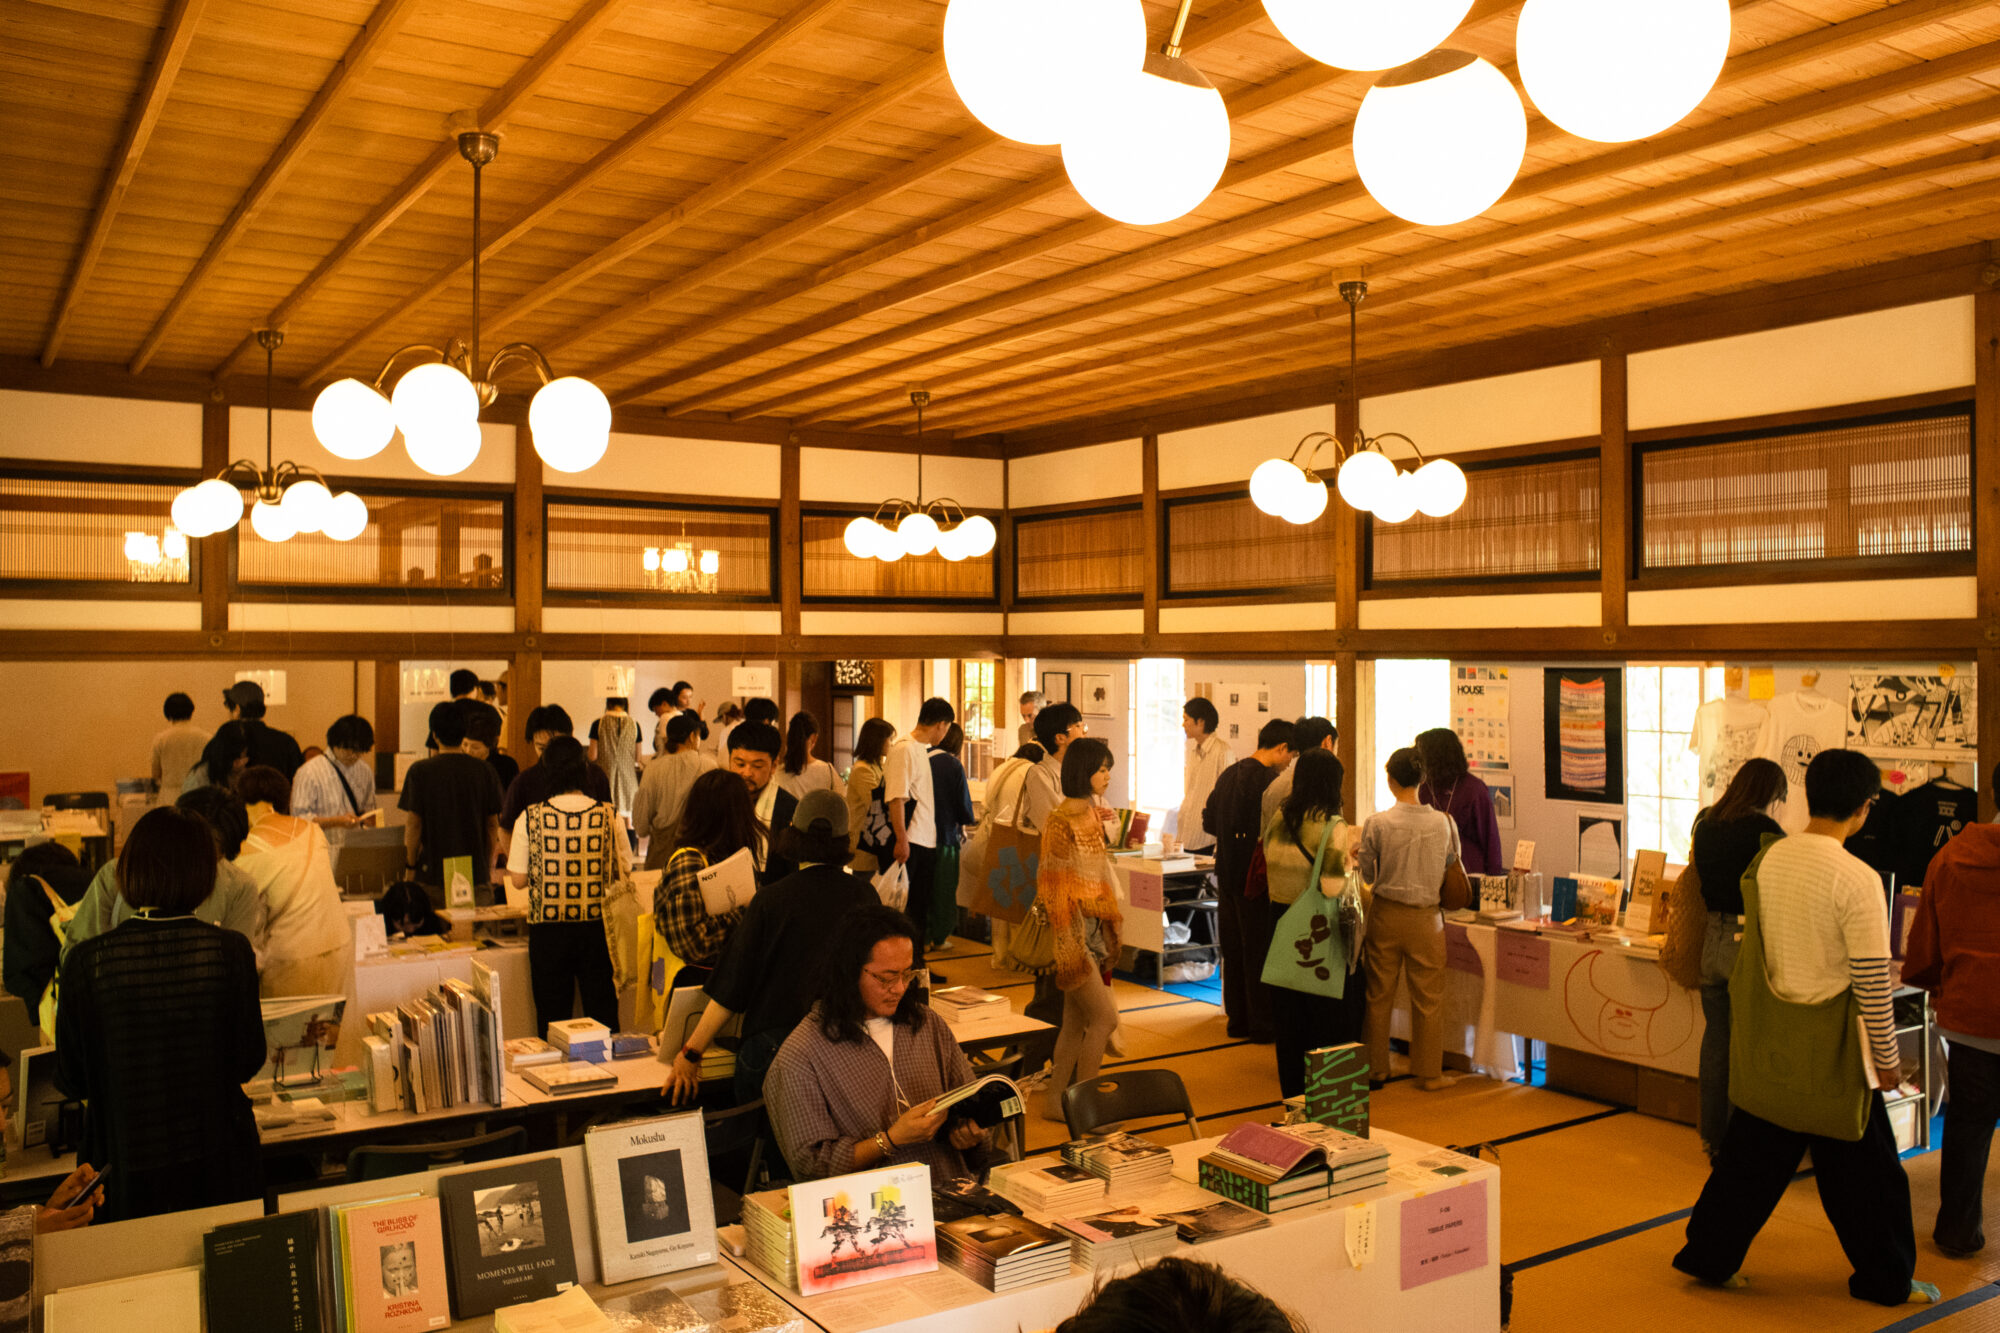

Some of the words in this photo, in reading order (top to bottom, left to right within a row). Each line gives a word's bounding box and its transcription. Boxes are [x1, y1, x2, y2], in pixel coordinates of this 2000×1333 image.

[1457, 684, 1485, 695] HOUSE
[701, 872, 717, 882] NOT
[630, 1131, 665, 1146] Mokusha
[372, 1219, 386, 1228] THE
[387, 1216, 407, 1225] BLISS
[377, 1221, 415, 1233] GIRLHOOD
[477, 1266, 516, 1280] MOMENTS
[517, 1263, 535, 1273] WILL
[536, 1258, 556, 1269] FADE
[387, 1299, 420, 1311] KRISTINA
[384, 1306, 423, 1319] ROZHKOVA
